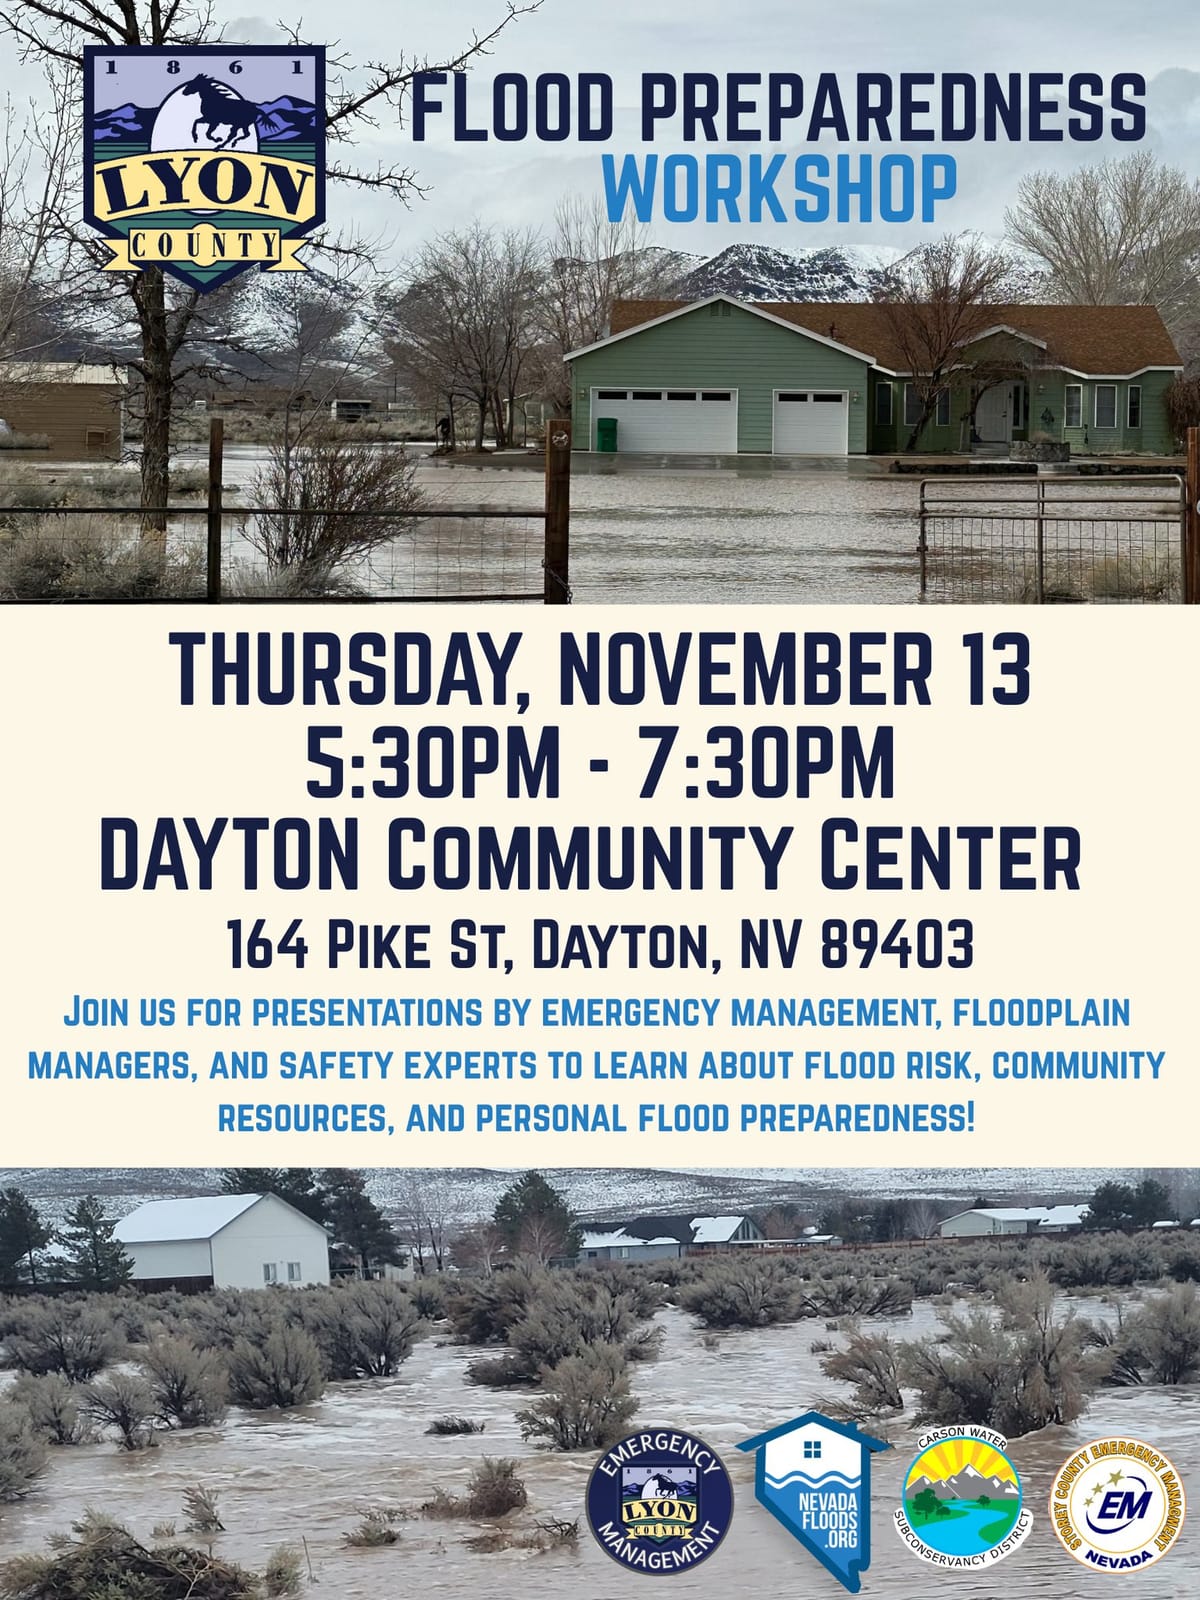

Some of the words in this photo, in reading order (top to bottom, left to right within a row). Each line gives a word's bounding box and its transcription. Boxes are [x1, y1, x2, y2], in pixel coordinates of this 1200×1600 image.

[412, 73, 613, 141] FLOOD
[642, 73, 1146, 141] PREPAREDNESS
[96, 156, 314, 215] LYON
[602, 154, 957, 222] WORKSHOP
[132, 232, 276, 257] COUNTY
[169, 632, 529, 714] THURSDAY,
[560, 632, 932, 705] NOVEMBER
[963, 632, 1030, 705] 13
[307, 726, 559, 798] 5:30PM
[639, 726, 893, 798] 7:30PM
[101, 817, 358, 890] DAYTON
[389, 817, 794, 890] COMMUNITY
[821, 817, 1080, 890] CENTER
[227, 919, 308, 968] 164
[329, 919, 430, 968] PIKE
[451, 919, 513, 975] ST,
[534, 919, 721, 975] DAYTON,
[741, 919, 803, 968] NV
[822, 919, 973, 968] 89403
[64, 995, 128, 1027] JOIN
[141, 998, 175, 1027] US
[188, 998, 240, 1027] FOR
[253, 998, 482, 1027] PRESENTATIONS
[494, 998, 532, 1027] BY
[543, 998, 720, 1027] EMERGENCY
[732, 998, 941, 1031] MANAGEMENT,
[954, 998, 1130, 1027] FLOODPLAIN
[29, 1050, 197, 1083] MANAGERS,
[209, 1050, 267, 1080] AND
[280, 1050, 393, 1080] SAFETY
[405, 1050, 536, 1080] EXPERTS
[548, 1050, 582, 1080] TO
[594, 1050, 687, 1080] LEARN
[699, 1050, 793, 1080] ABOUT
[805, 1050, 894, 1080] FLOOD
[907, 1050, 980, 1083] RISK,
[993, 1050, 1165, 1080] COMMUNITY
[219, 1103, 394, 1135] RESOURCES,
[406, 1103, 464, 1132] AND
[477, 1103, 627, 1132] PERSONAL
[639, 1103, 729, 1132] FLOOD
[741, 1100, 974, 1132] PREPAREDNESS!
[599, 1433, 721, 1477] EMERGENCY
[918, 1427, 965, 1449] CARSON
[969, 1427, 1007, 1450] WATER
[1090, 1441, 1168, 1472] EMERGENCY
[1055, 1451, 1091, 1499] COUNTY
[624, 1500, 696, 1520] LYON
[799, 1492, 858, 1511] NEVADA
[1097, 1491, 1153, 1519] EM
[635, 1525, 685, 1535] COUNTY
[802, 1511, 858, 1530] FLOODS
[894, 1510, 986, 1567] SUBCONSERVANCY
[990, 1511, 1030, 1559] DISTRICT
[1054, 1502, 1082, 1550] STOREY
[598, 1521, 720, 1569] MANAGEMENT
[824, 1530, 858, 1549] .ORG
[1085, 1549, 1153, 1569] NEVADA
